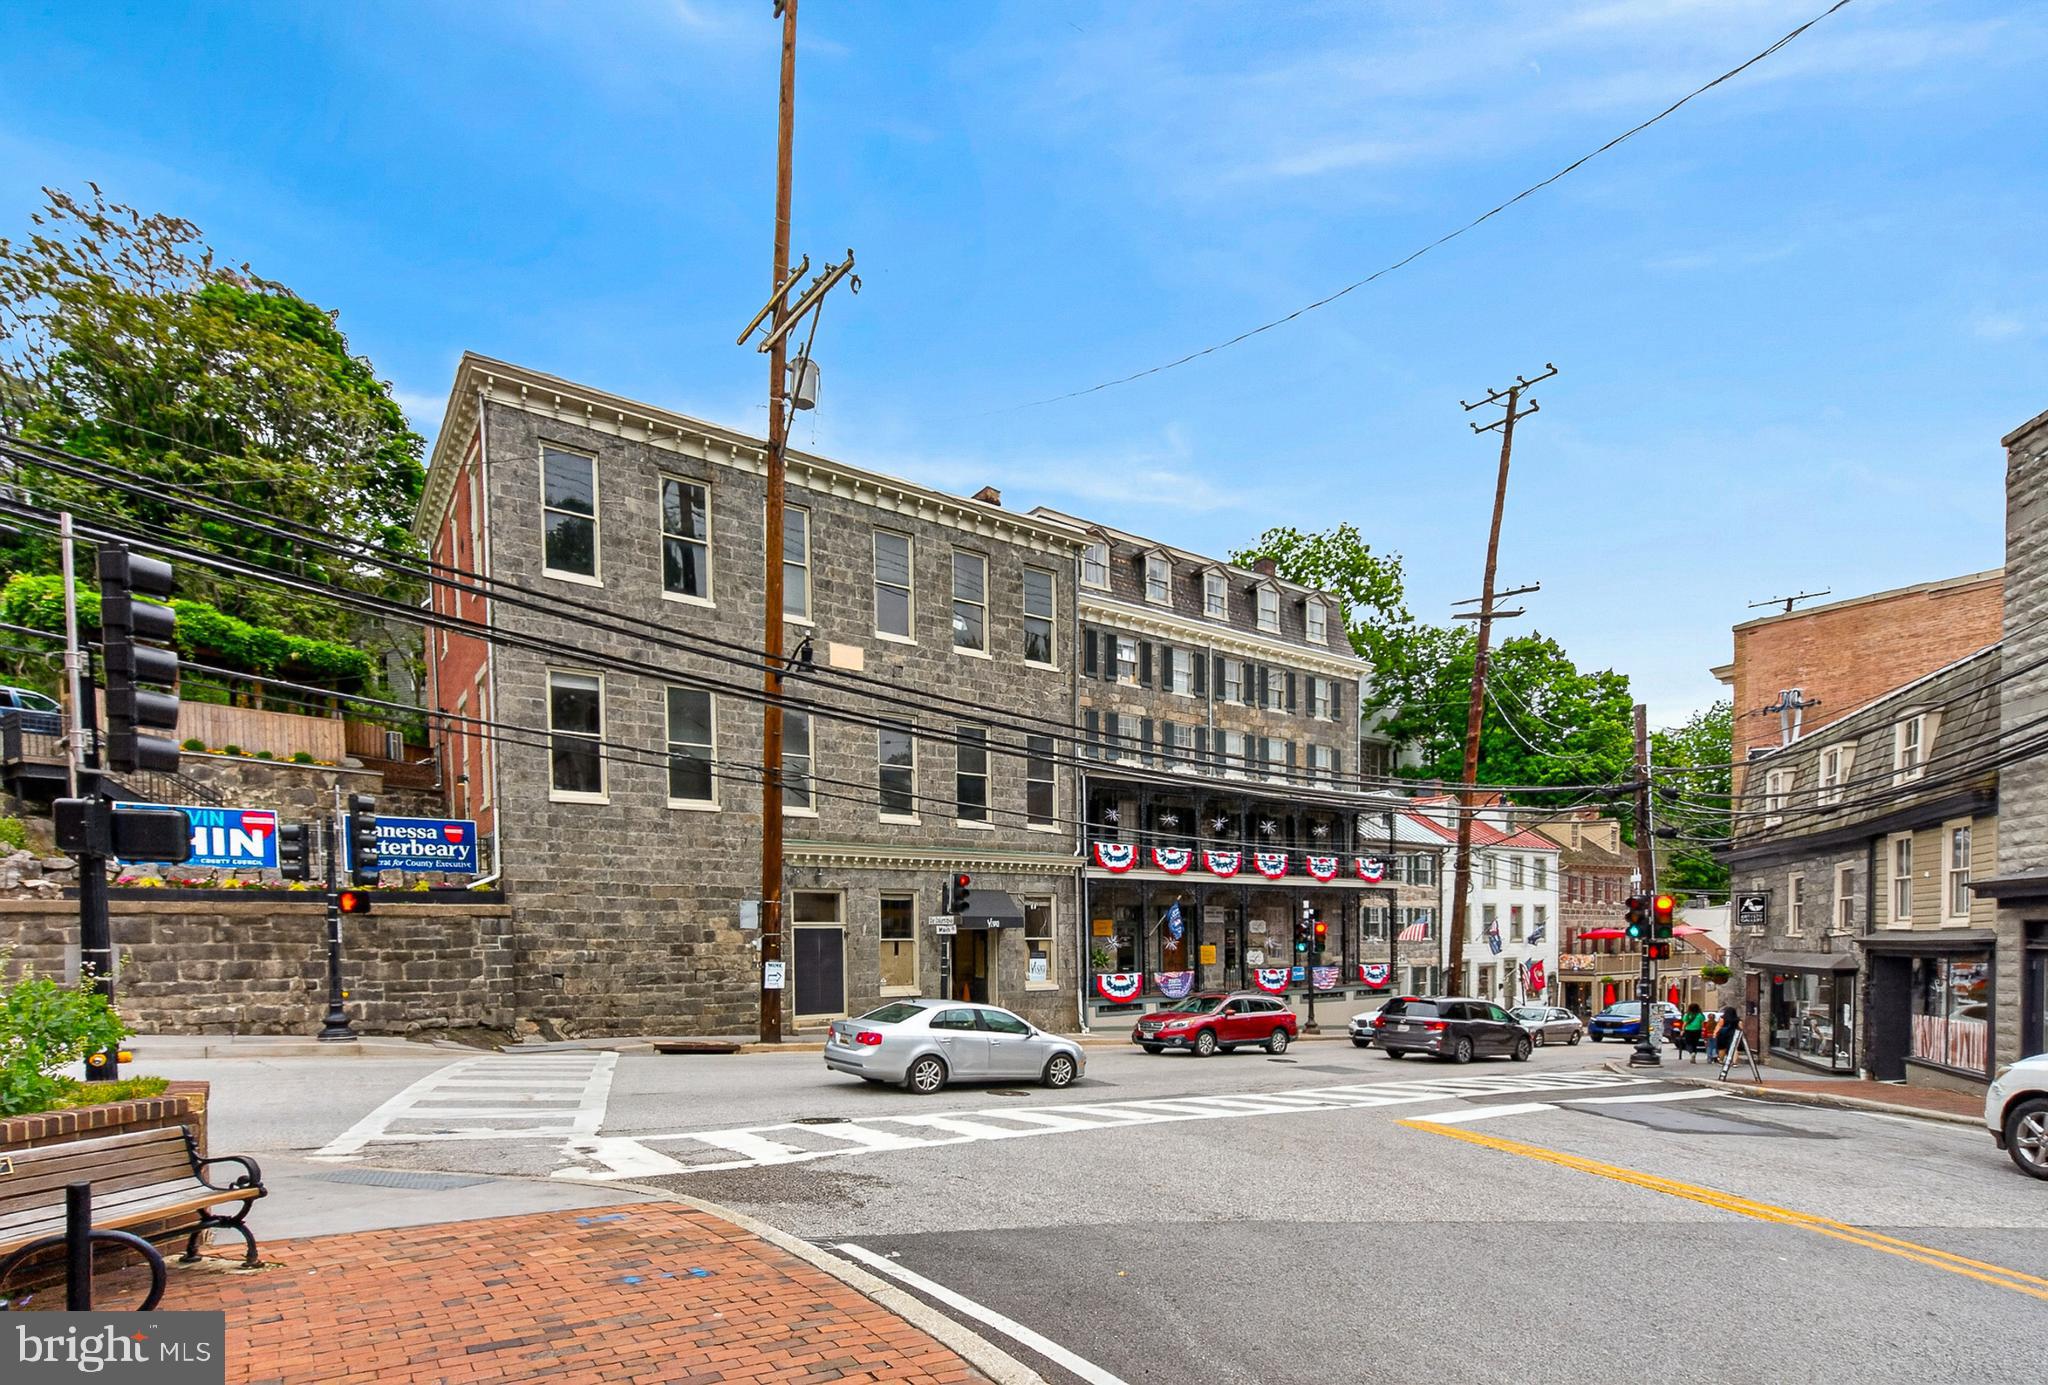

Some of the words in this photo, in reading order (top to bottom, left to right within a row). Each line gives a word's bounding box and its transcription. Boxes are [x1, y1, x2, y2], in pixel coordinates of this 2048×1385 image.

[362, 825, 437, 839] anessa
[363, 839, 470, 860] terbeary
[391, 859, 404, 867] for
[405, 860, 433, 868] County
[436, 860, 472, 868] Executive
